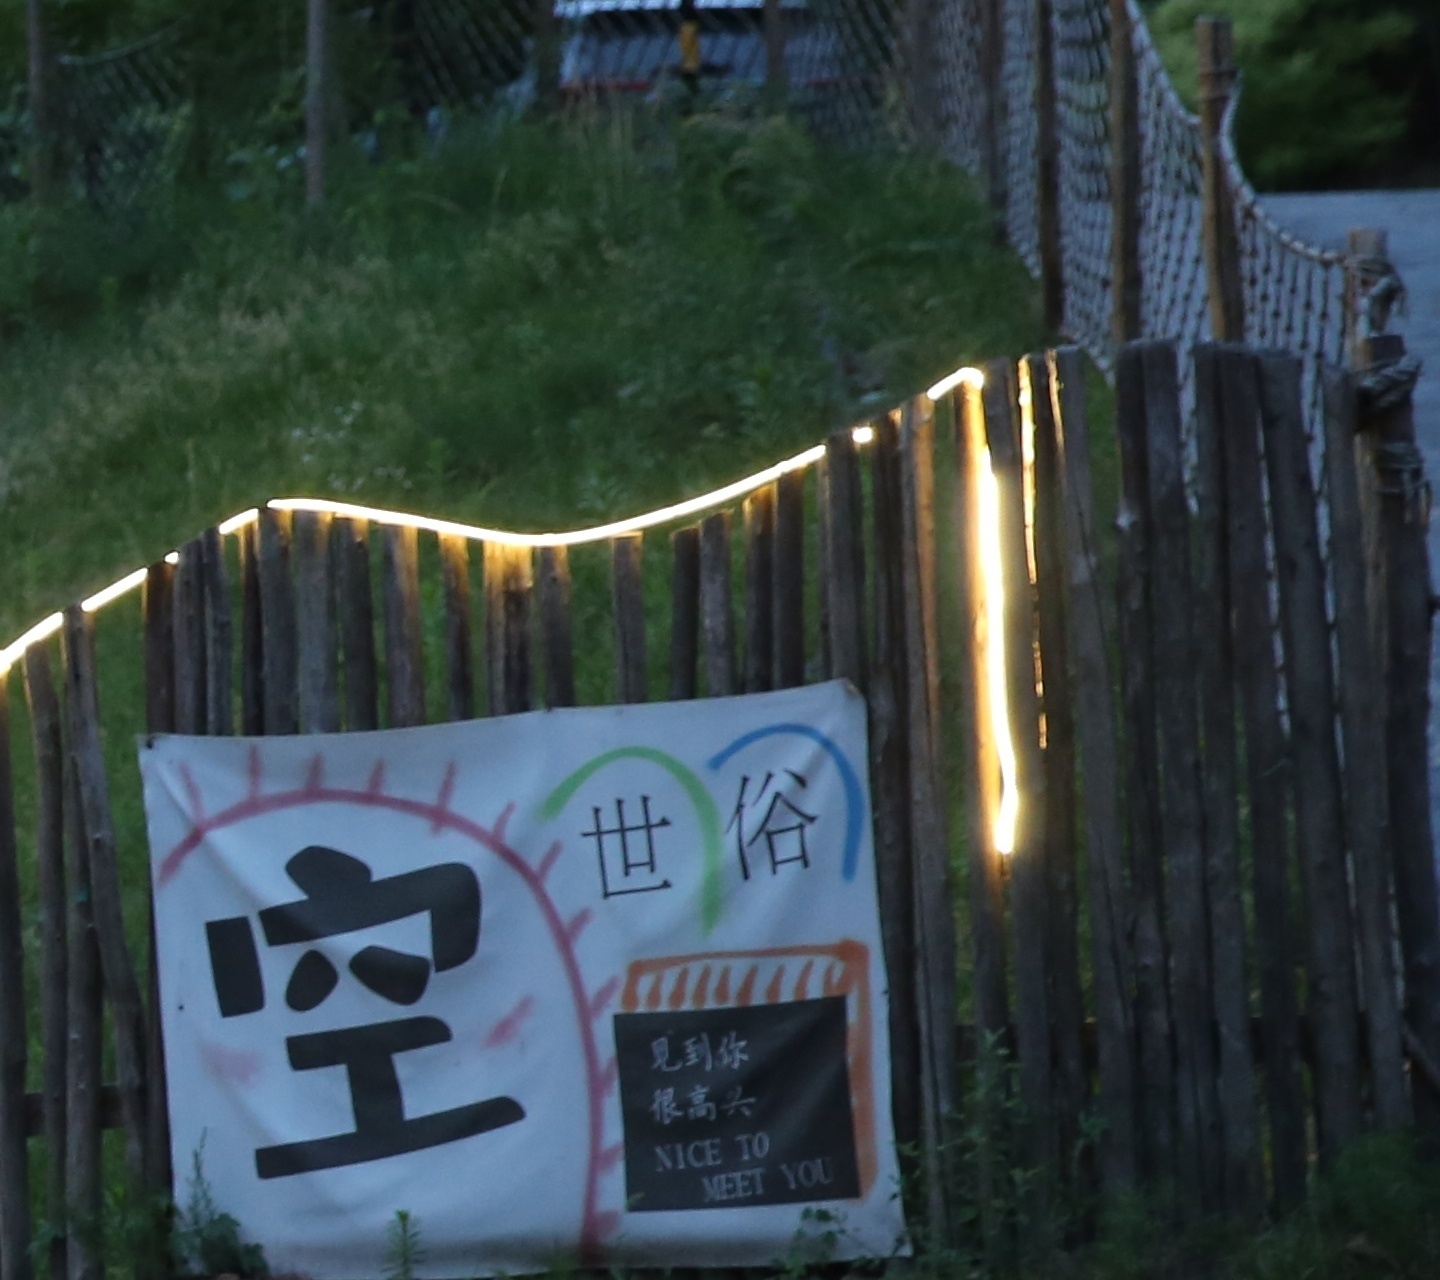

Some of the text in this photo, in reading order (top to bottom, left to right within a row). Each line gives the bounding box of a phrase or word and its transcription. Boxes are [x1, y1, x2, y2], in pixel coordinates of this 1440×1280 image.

[580, 767, 819, 901] 世俗
[205, 844, 527, 1181] 空
[651, 1031, 750, 1072] 见到你
[654, 1131, 771, 1172] NICE TO
[702, 1157, 834, 1202] MEET YOU
